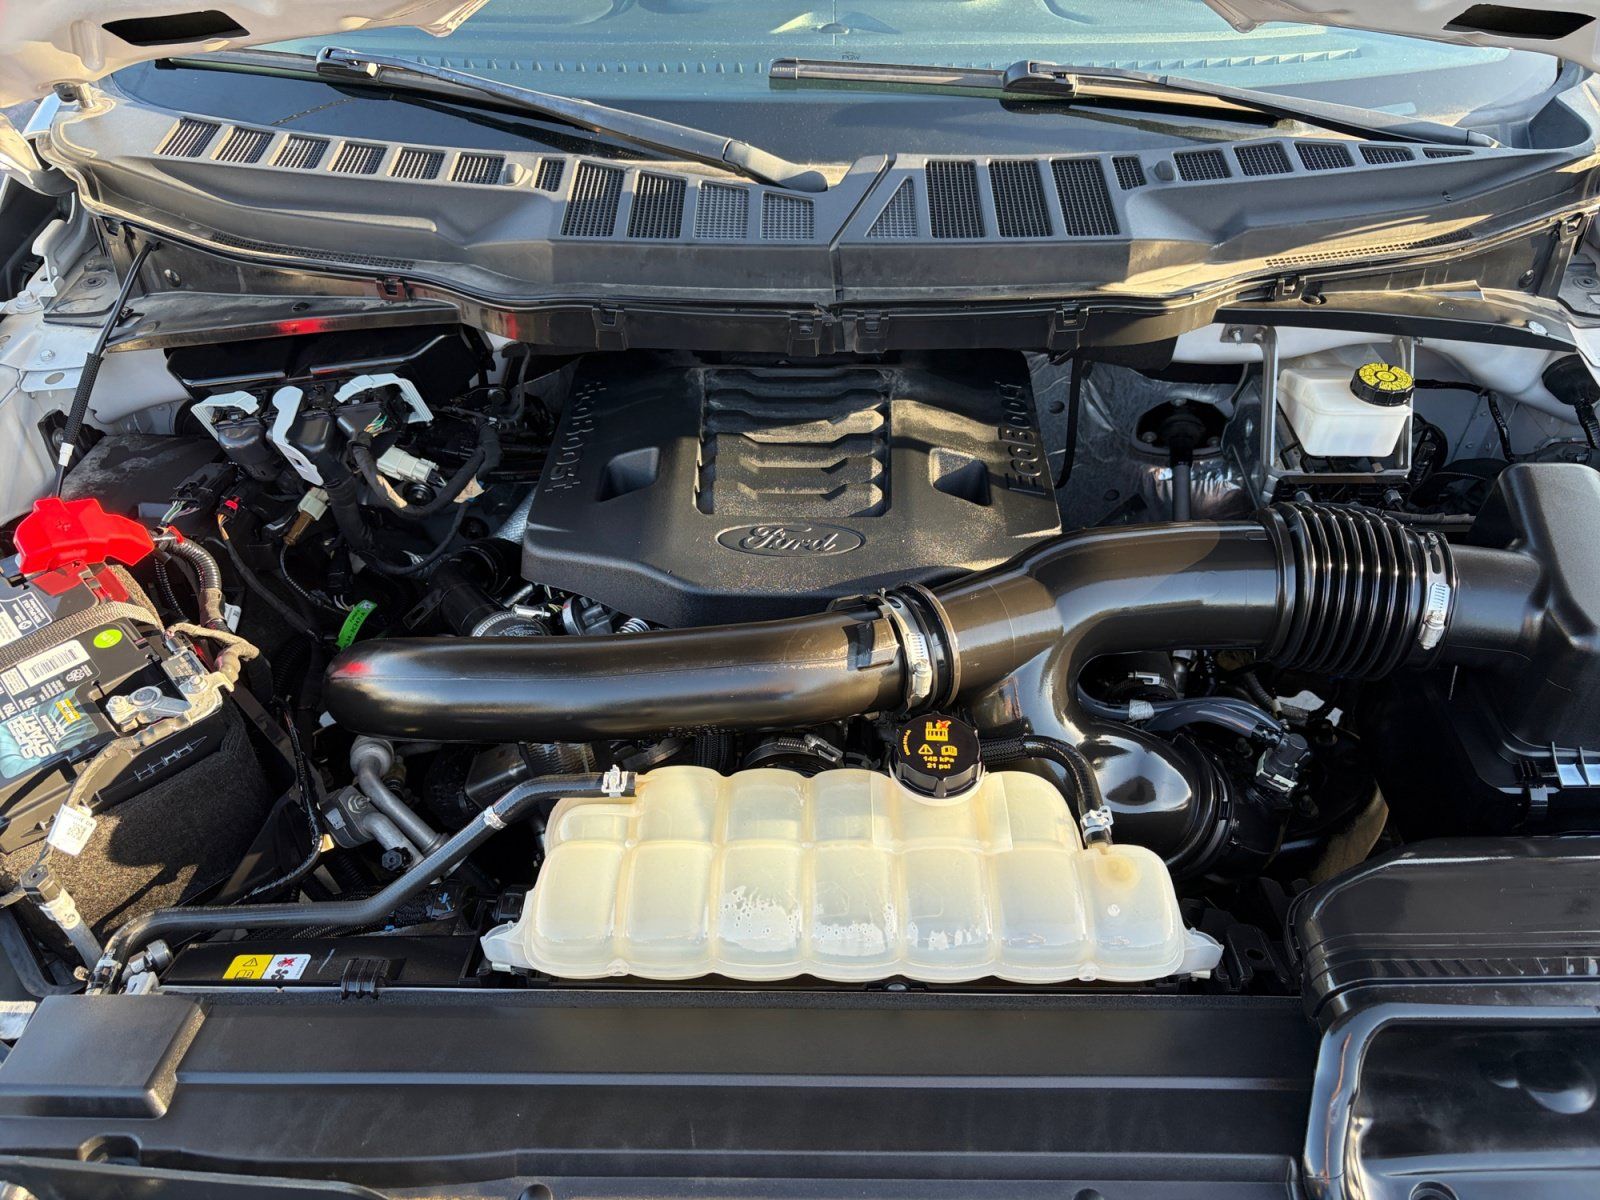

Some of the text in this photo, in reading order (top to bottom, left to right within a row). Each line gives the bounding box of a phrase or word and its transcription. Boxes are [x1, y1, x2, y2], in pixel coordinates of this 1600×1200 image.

[995, 382, 1047, 496] EcoBoost
[738, 526, 839, 552] Ford
[0, 702, 16, 720] 760
[19, 696, 37, 711] 70
[6, 716, 36, 759] SUPER
[19, 714, 57, 758] START
[939, 755, 955, 763] kPa
